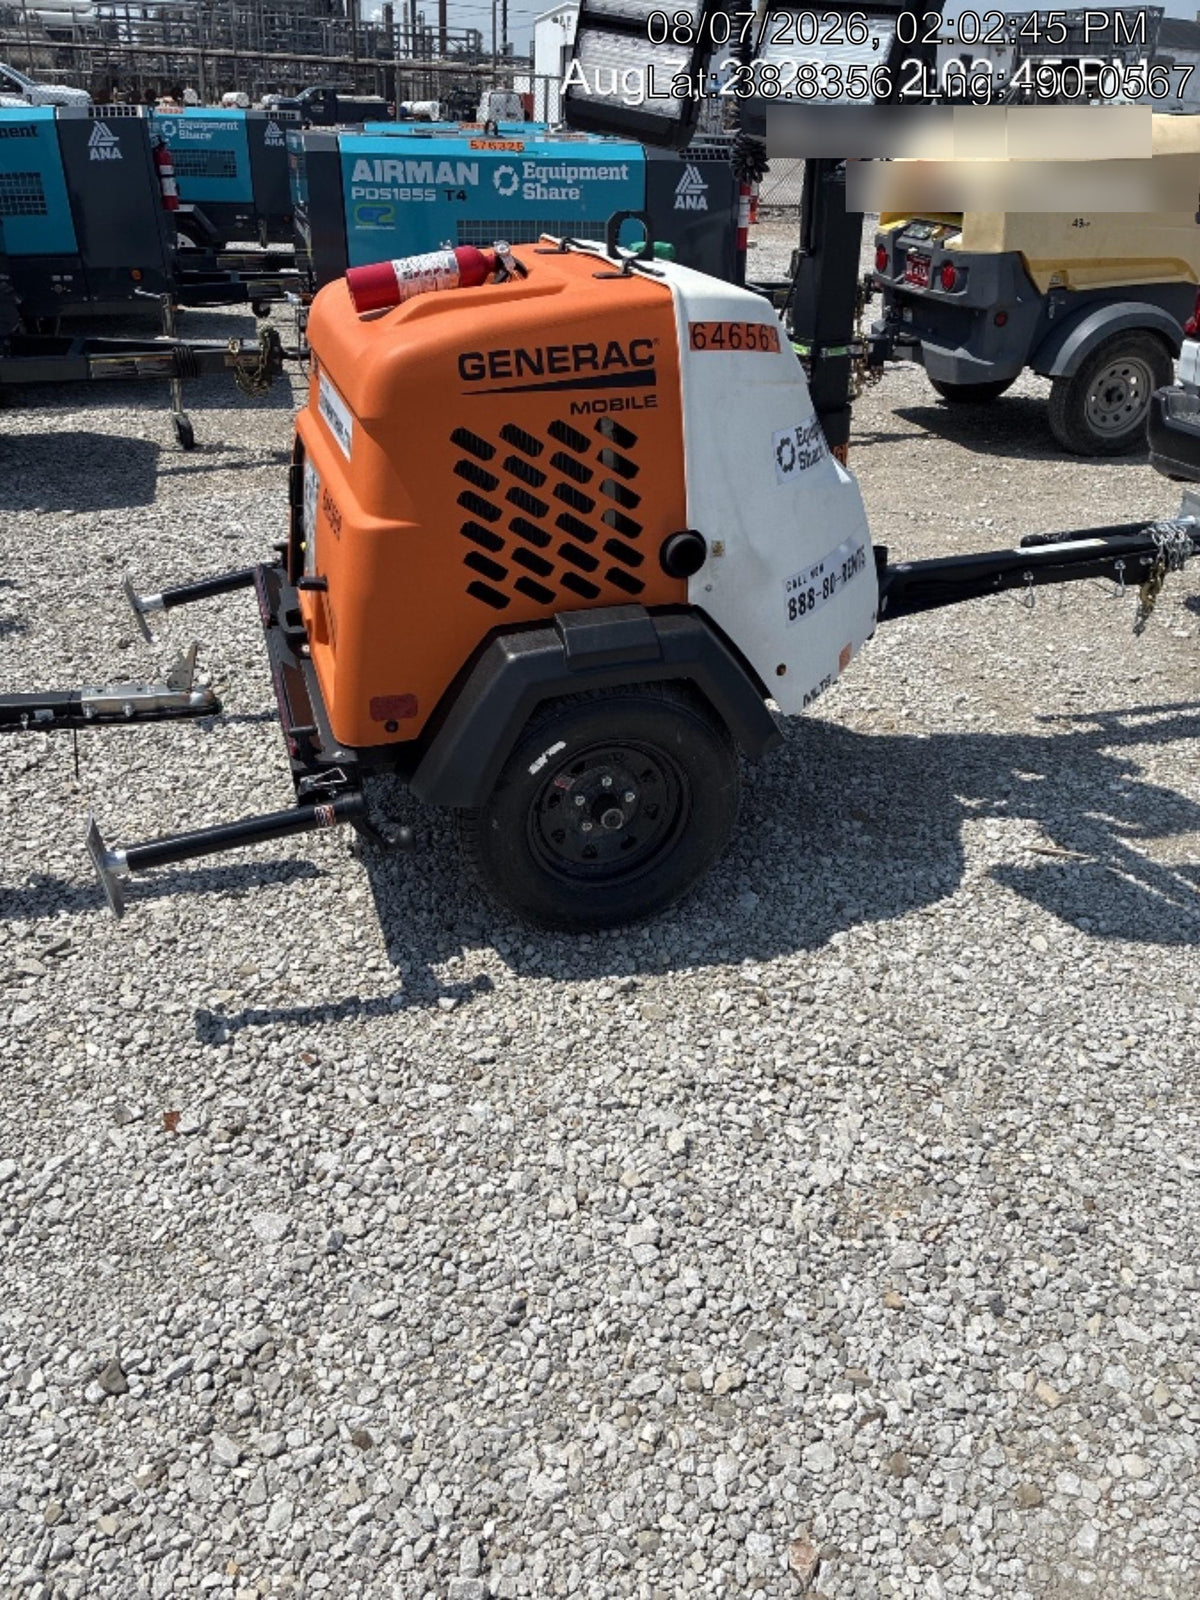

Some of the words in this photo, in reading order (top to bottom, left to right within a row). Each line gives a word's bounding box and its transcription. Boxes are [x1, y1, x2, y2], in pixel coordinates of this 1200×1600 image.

[90, 147, 123, 160] ANA
[352, 159, 479, 186] AIRMAN
[522, 161, 629, 182] Equipment
[443, 189, 467, 202] T4
[523, 185, 580, 200] Share
[673, 195, 708, 210] ANA
[458, 338, 655, 381] GENERAC
[570, 394, 658, 415] MOBILE
